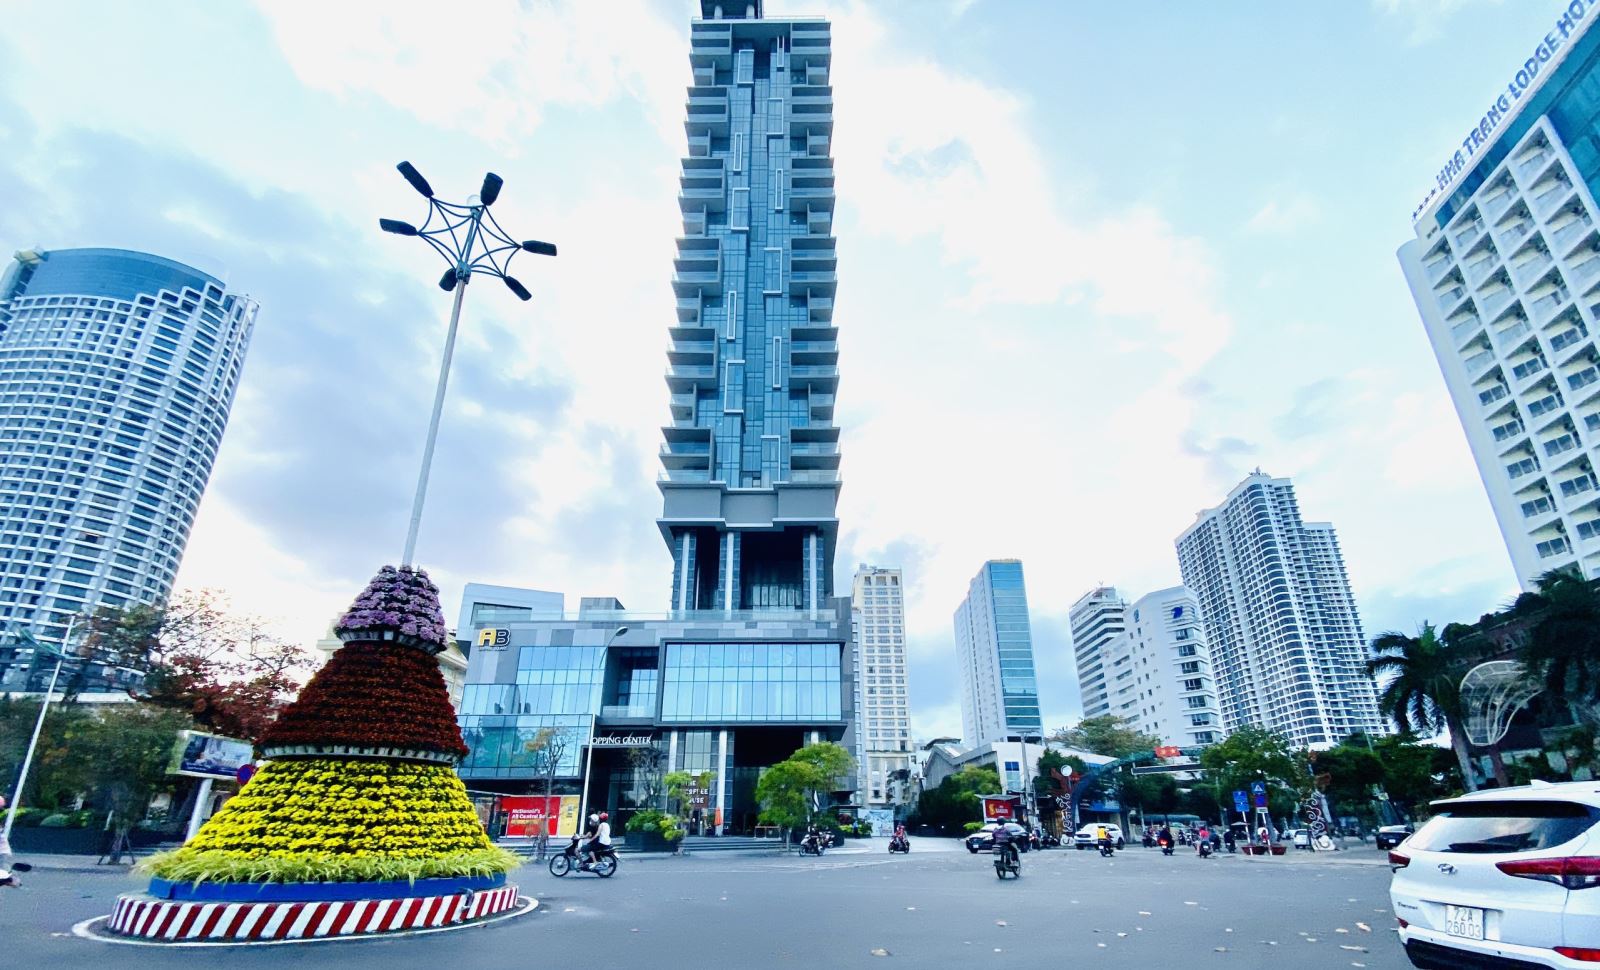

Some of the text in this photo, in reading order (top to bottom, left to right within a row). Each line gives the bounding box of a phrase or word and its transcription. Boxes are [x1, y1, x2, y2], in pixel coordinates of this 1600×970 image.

[1462, 94, 1510, 156] TRANG
[1508, 31, 1560, 99] LODGE
[1553, 0, 1596, 38] HO
[477, 627, 511, 647] AB
[622, 732, 652, 744] CENTER
[1454, 907, 1473, 922] 72A
